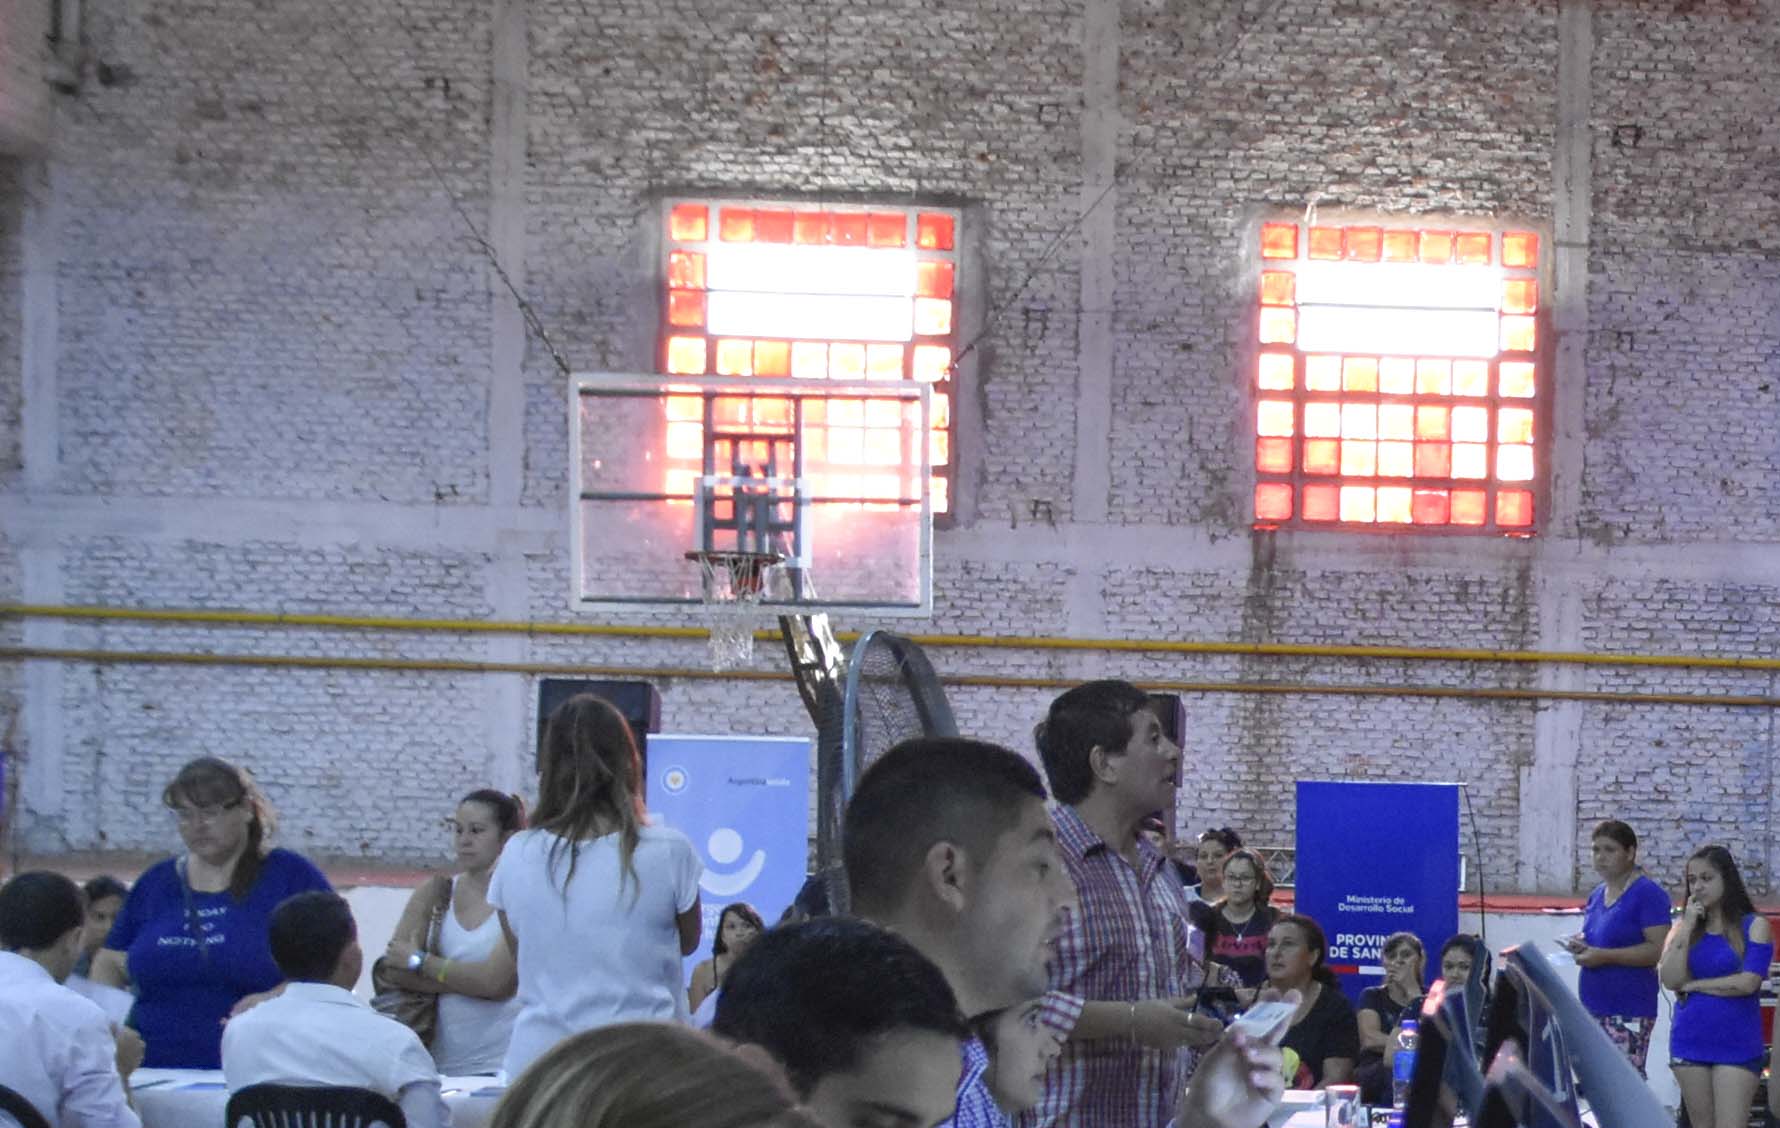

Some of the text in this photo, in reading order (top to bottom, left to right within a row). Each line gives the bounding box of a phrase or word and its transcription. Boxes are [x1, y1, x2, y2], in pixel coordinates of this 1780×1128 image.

[1346, 895, 1405, 905] Ministerio de
[1338, 903, 1415, 914] Desarrollo Social
[158, 934, 225, 946] NOTHNG
[1336, 933, 1390, 946] PROVIN
[1329, 946, 1383, 960] DE SAN
